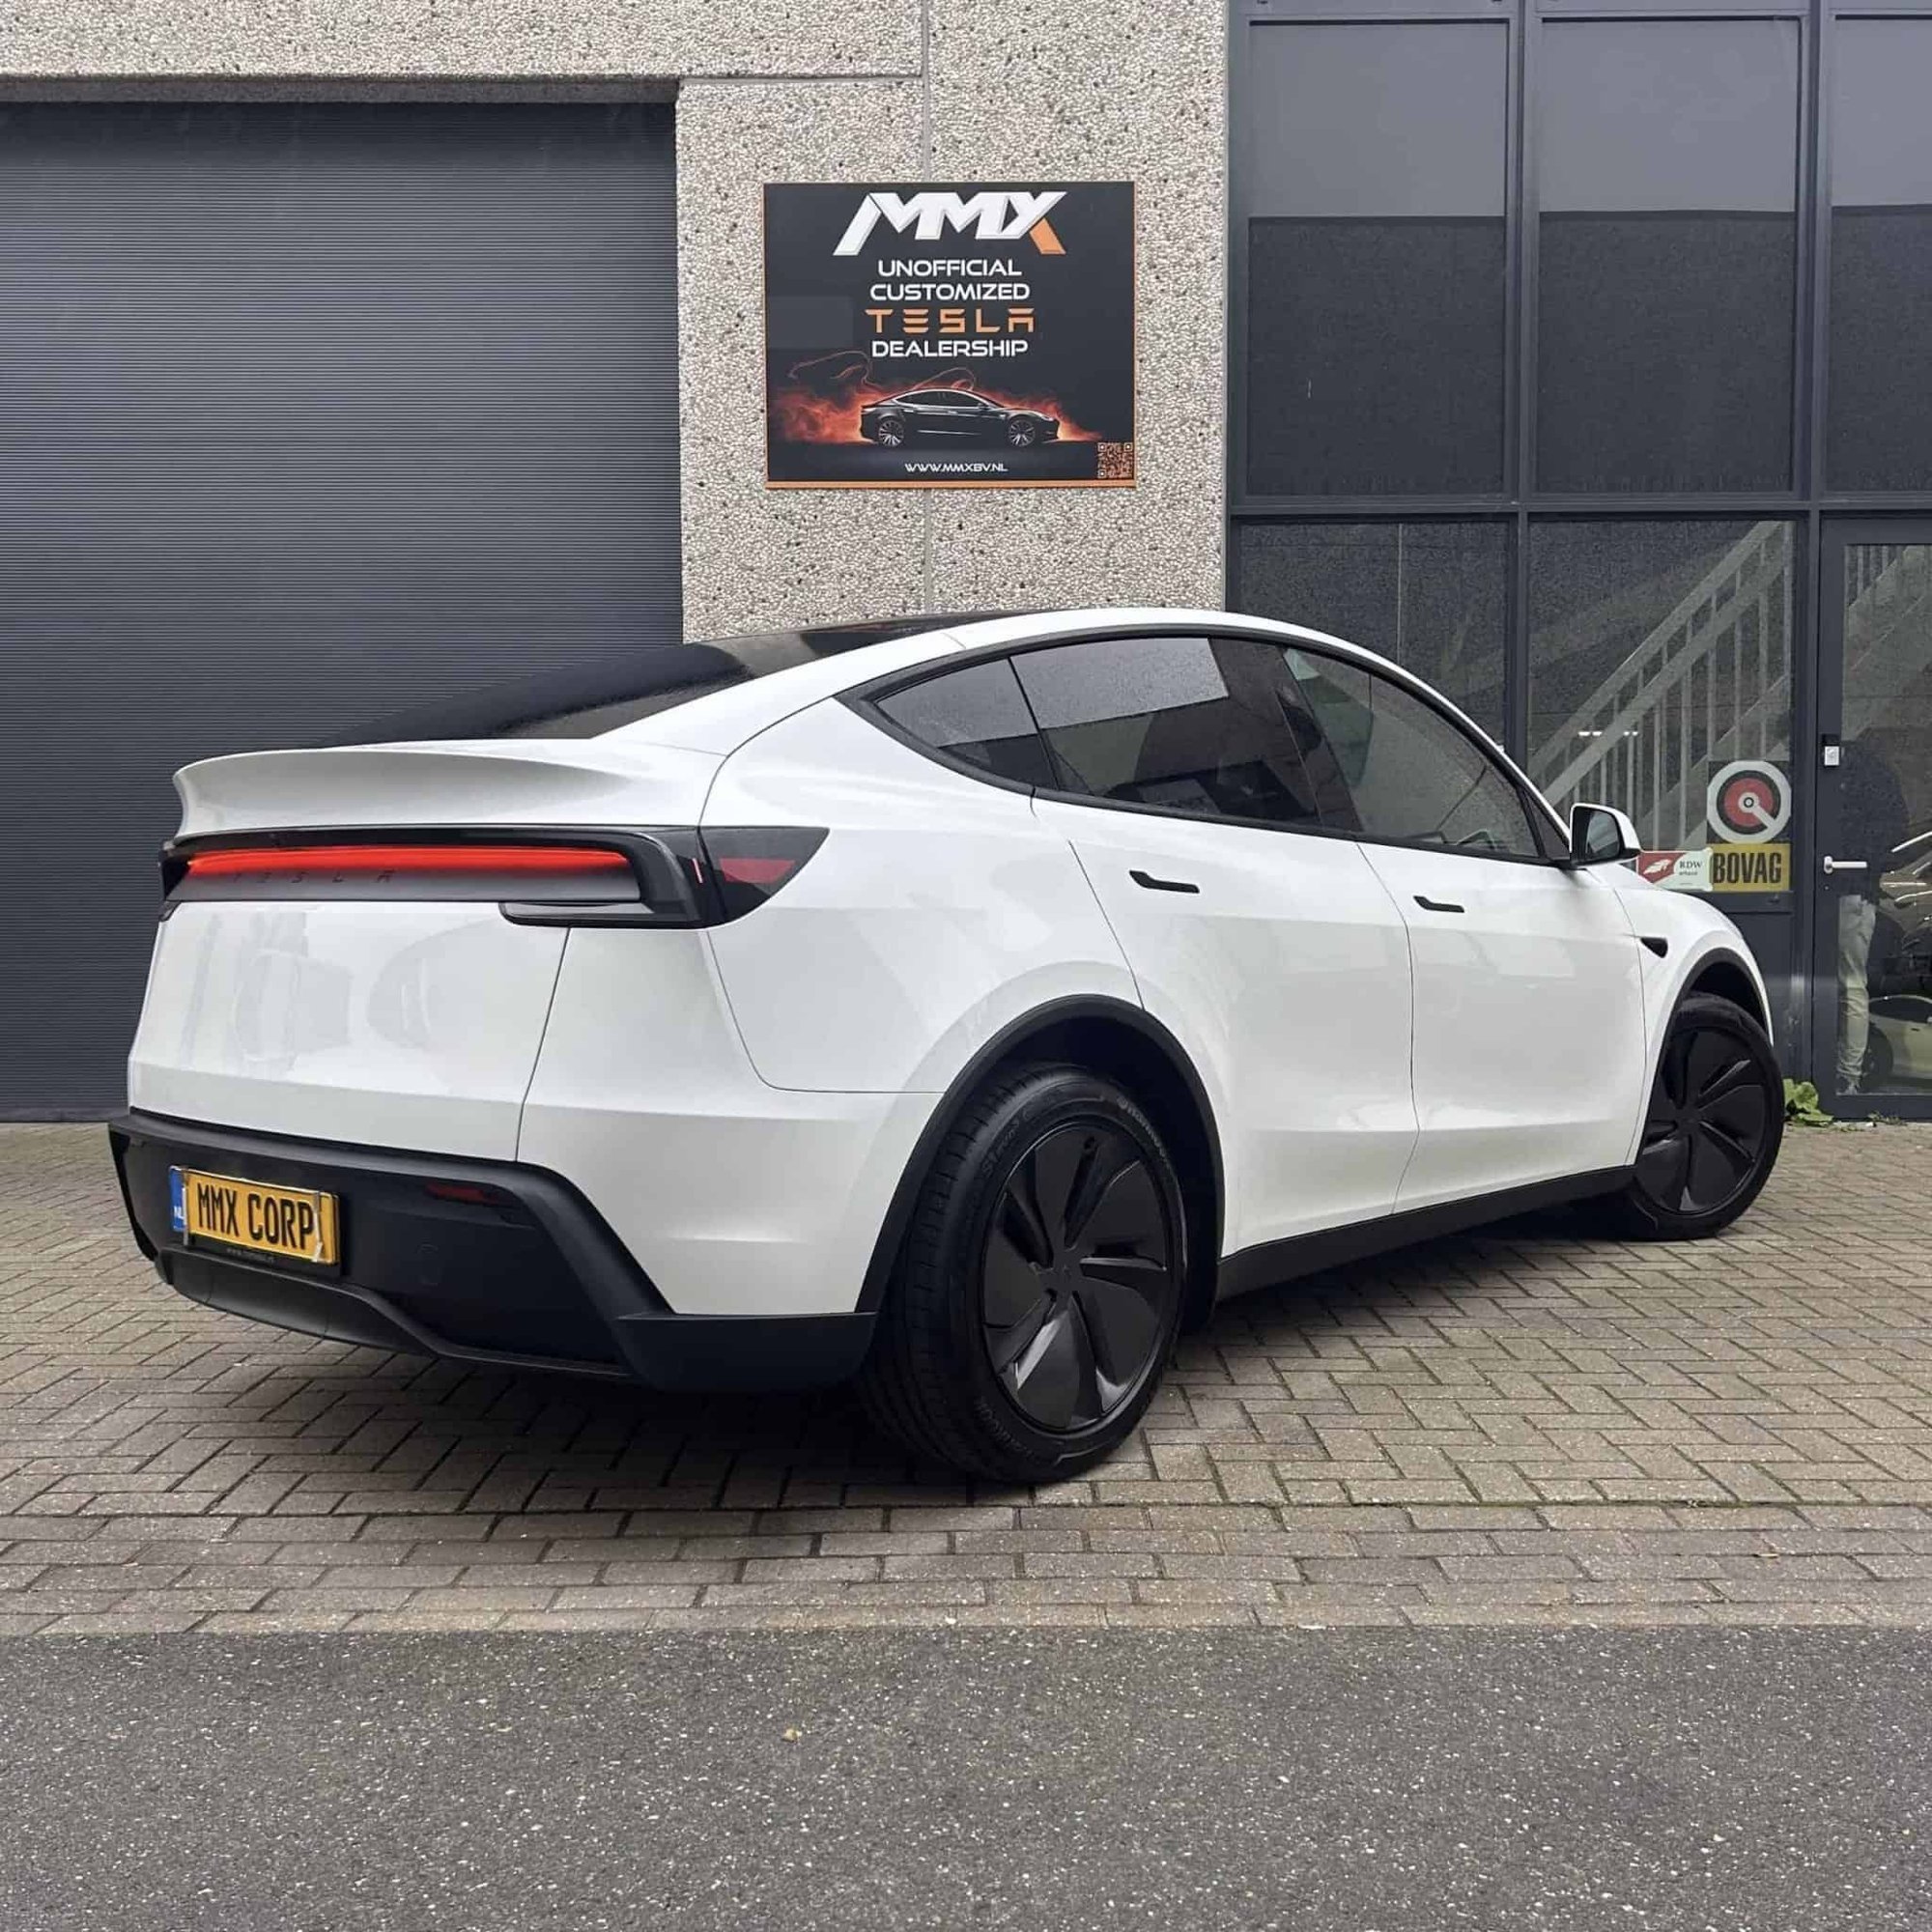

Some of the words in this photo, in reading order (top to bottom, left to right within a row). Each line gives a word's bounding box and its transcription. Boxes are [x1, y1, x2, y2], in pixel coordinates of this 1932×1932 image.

[833, 192, 1066, 256] MMX
[877, 259, 1022, 277] UNOFFICIAL
[869, 282, 1031, 301] CUSTOMIZED
[865, 307, 1036, 333] TESLA
[871, 339, 1029, 357] DEALERSHIP
[904, 462, 1009, 473] WWW.MMXBV.NL
[1713, 852, 1782, 884] BOVAG
[197, 1182, 240, 1237] MMX
[247, 1192, 314, 1250] CORP
